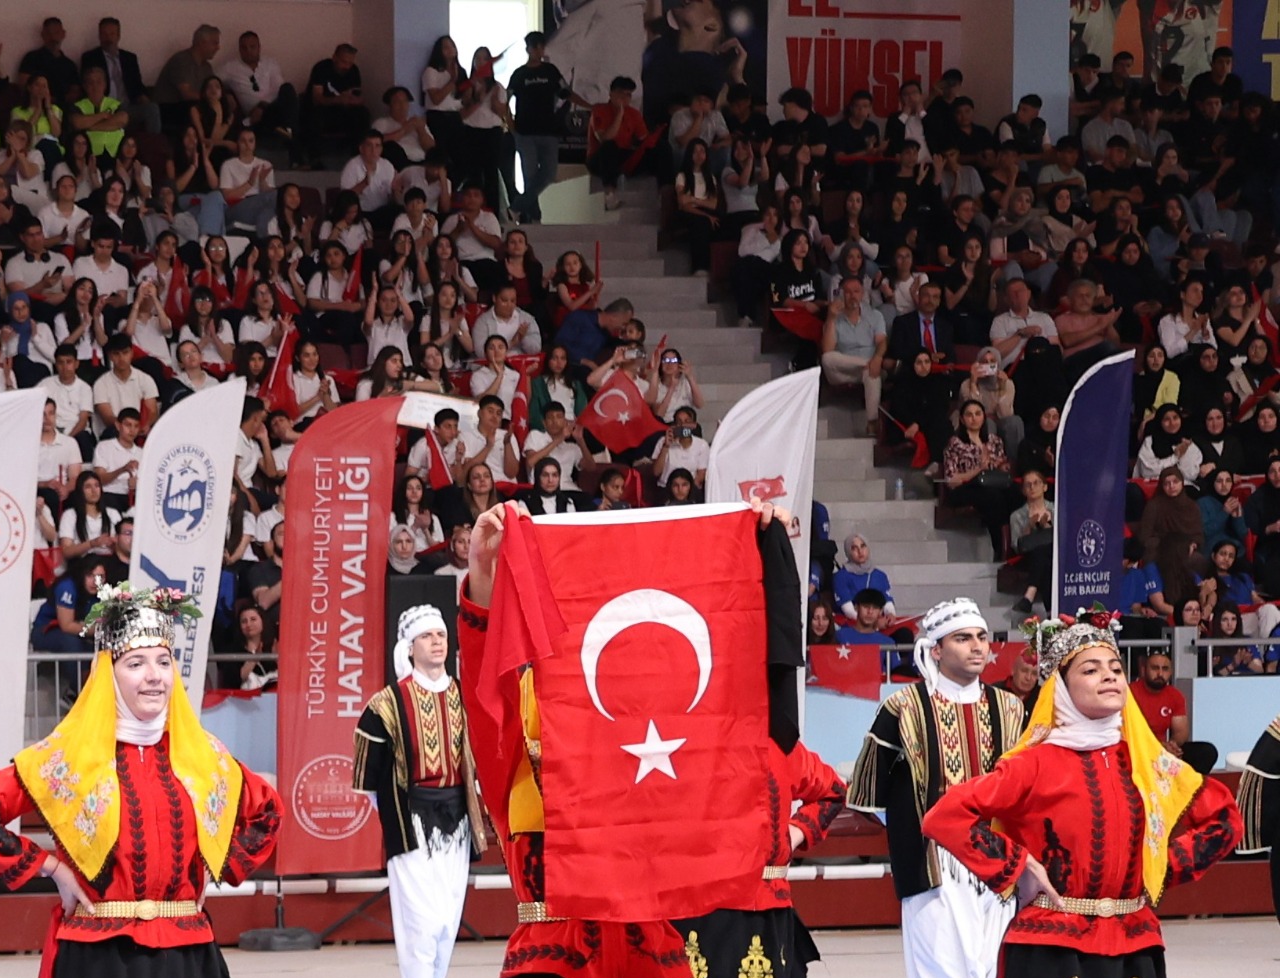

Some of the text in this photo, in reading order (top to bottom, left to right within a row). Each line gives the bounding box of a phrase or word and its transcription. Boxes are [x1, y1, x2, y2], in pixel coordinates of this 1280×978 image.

[305, 456, 333, 719] TÜRKİYE CUMHURİYETİ
[337, 456, 371, 718] HATAY VALİLİĞİ
